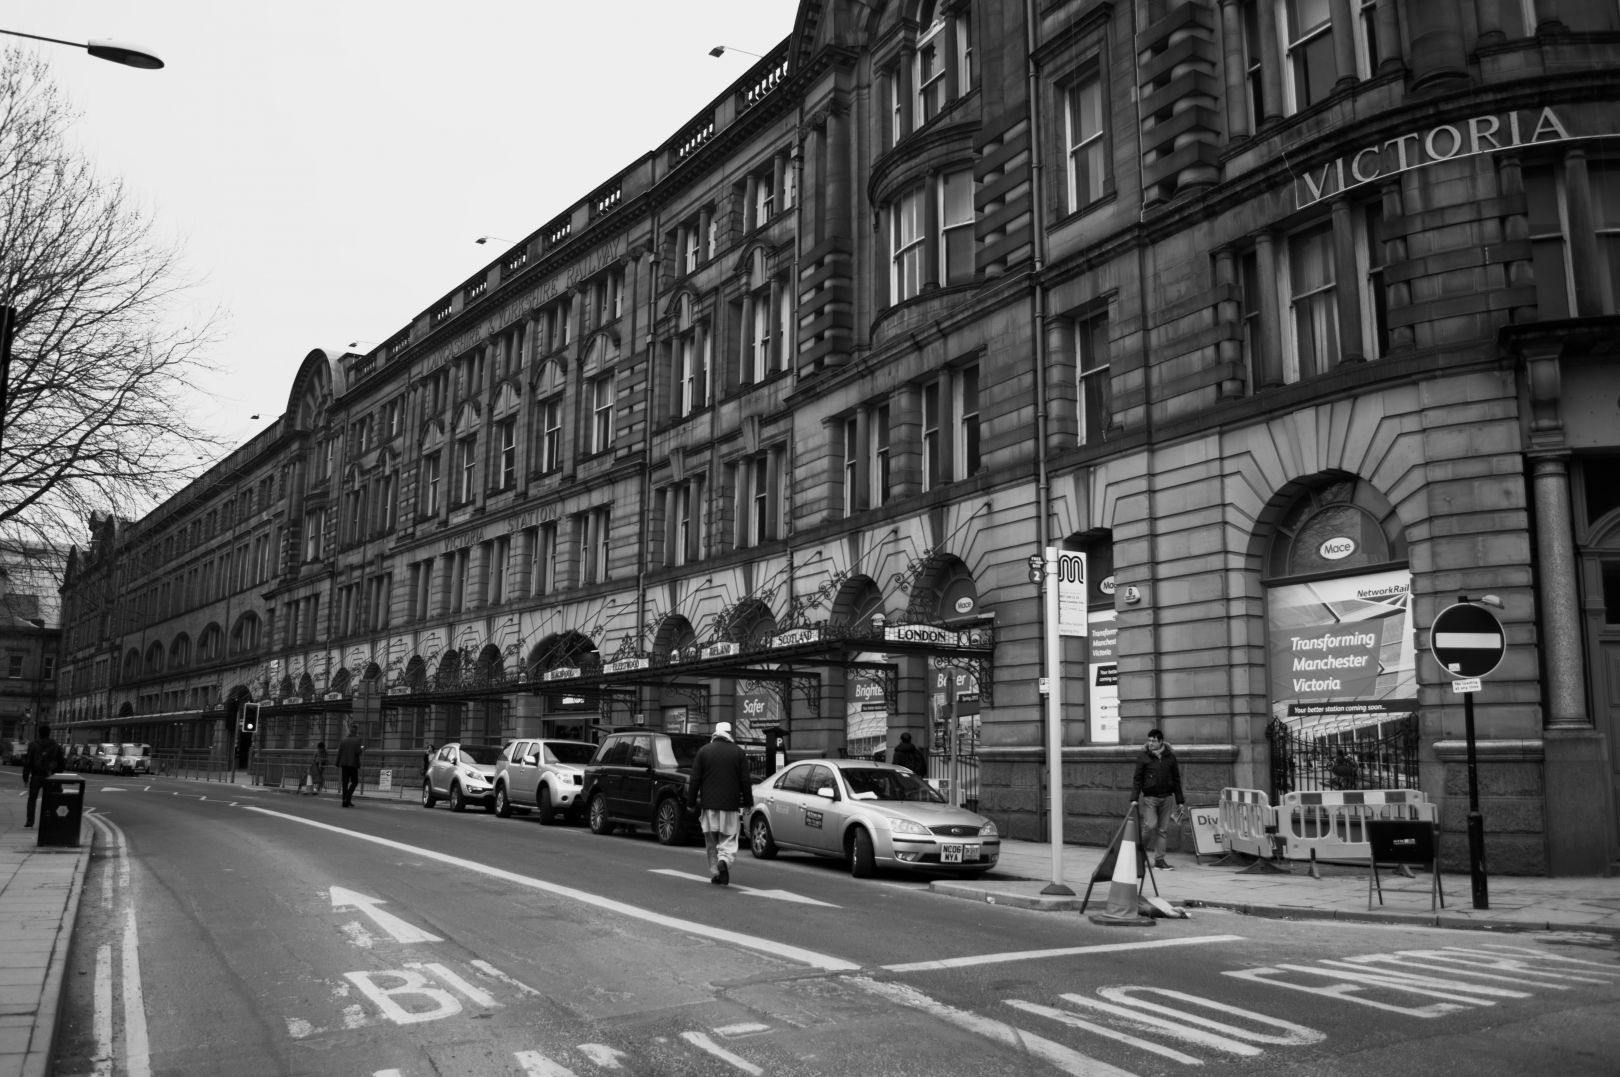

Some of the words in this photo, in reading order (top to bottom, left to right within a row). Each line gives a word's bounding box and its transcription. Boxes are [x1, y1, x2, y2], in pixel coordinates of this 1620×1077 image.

[1302, 106, 1570, 201] VICTORIA
[507, 503, 557, 533] STATION
[1324, 543, 1352, 555] Mace
[1033, 571, 1041, 581] 2
[778, 630, 812, 646] SCOTLAND
[897, 628, 946, 643] LONDON
[1093, 638, 1117, 647] Manchest
[1290, 631, 1376, 651] Transforming
[1292, 655, 1368, 672] Manchester
[936, 673, 967, 688] Ber
[1292, 676, 1342, 692] Victoria
[855, 683, 885, 700] Brighte
[743, 698, 765, 717] Safer
[1294, 706, 1306, 714] Your
[1307, 704, 1325, 713] better
[1325, 704, 1345, 712] station
[1346, 703, 1367, 713] coming
[776, 737, 783, 748] P
[1197, 815, 1219, 826] Div
[1000, 985, 1327, 1066] NO
